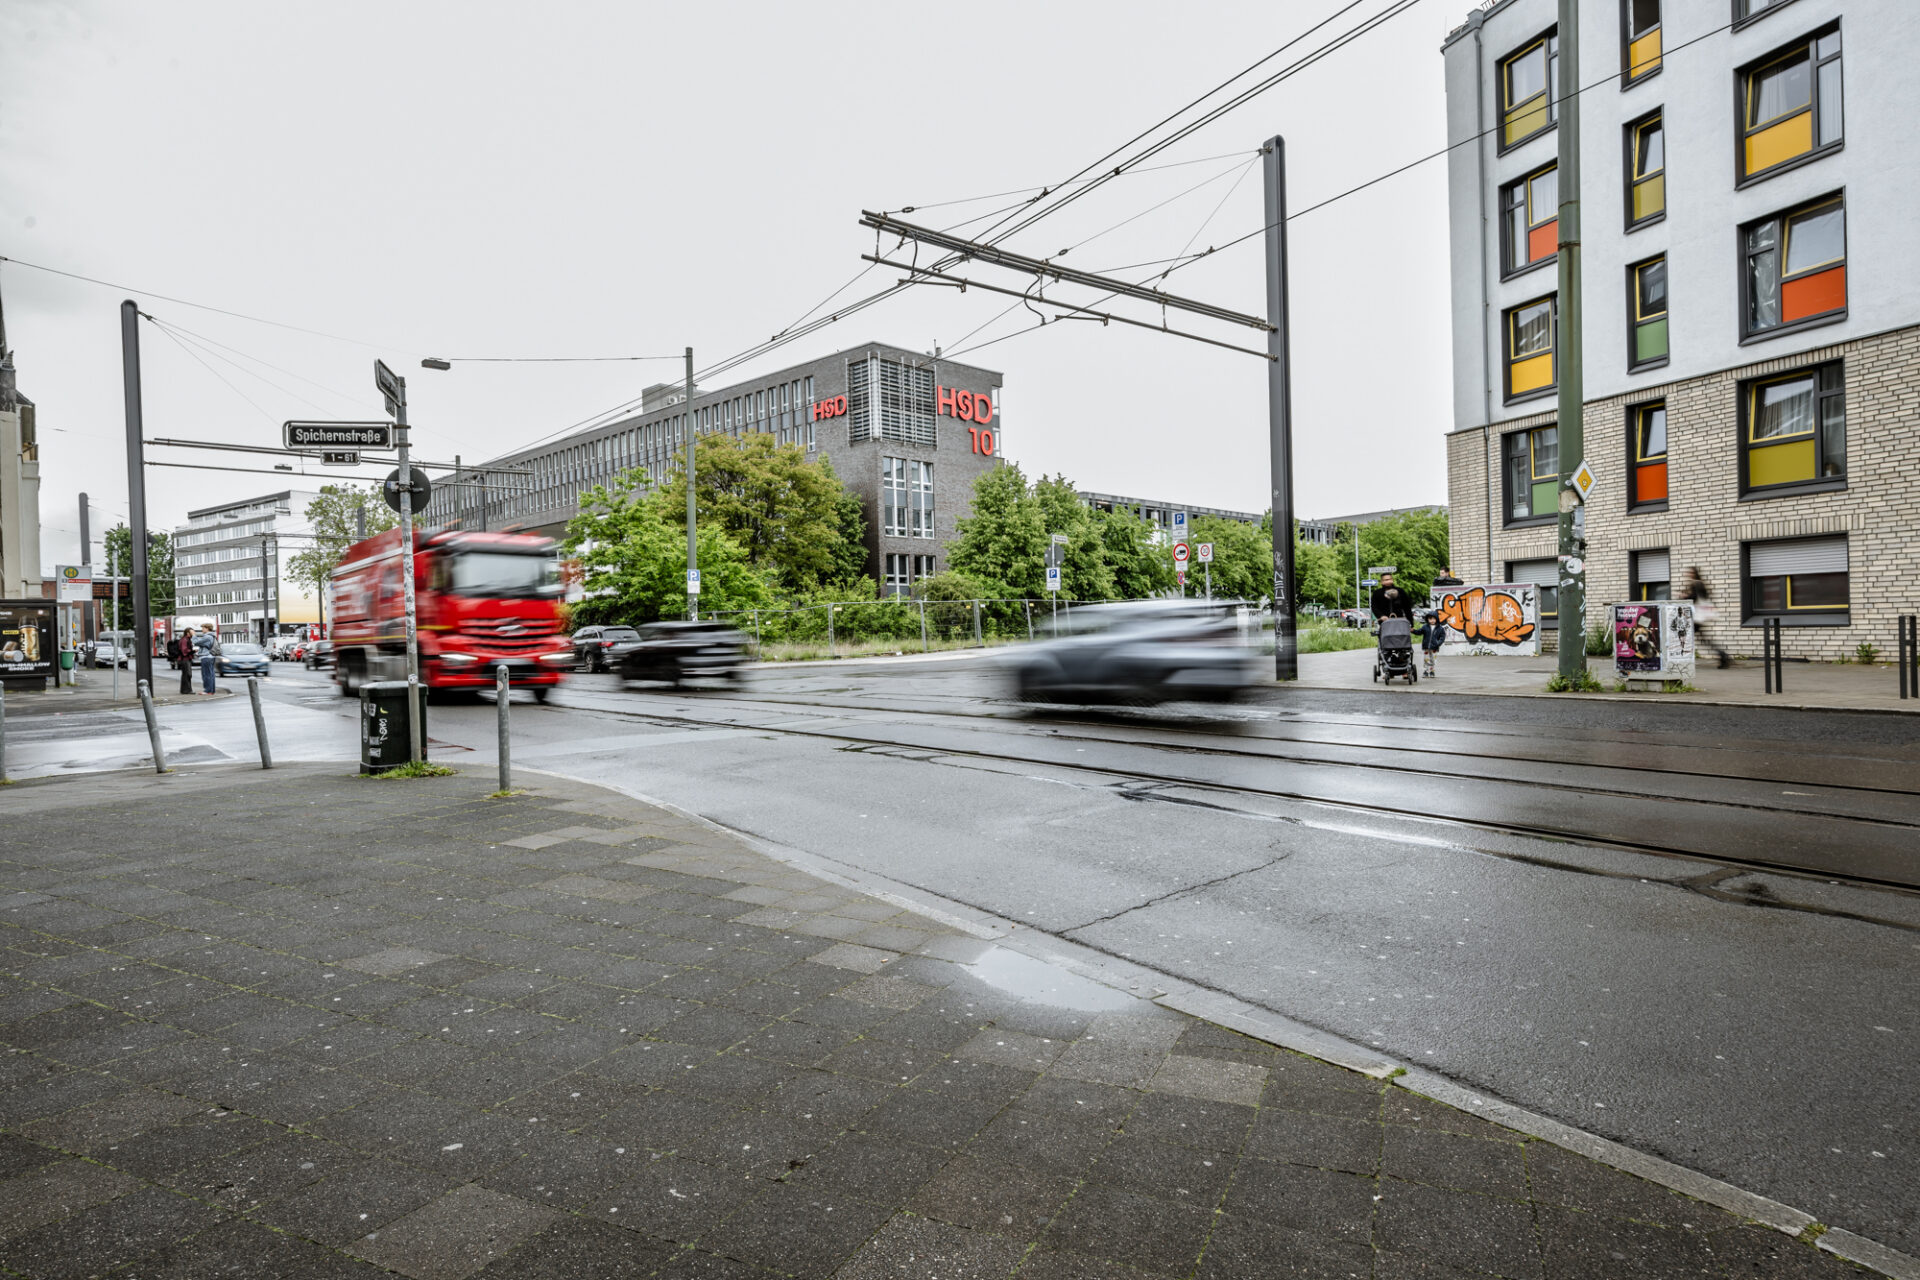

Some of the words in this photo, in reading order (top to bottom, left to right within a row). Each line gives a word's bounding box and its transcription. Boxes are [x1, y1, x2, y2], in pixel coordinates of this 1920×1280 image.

[813, 395, 847, 421] HSD
[937, 385, 993, 424] HSD
[295, 428, 381, 444] Spichernstraße
[969, 428, 993, 456] 10
[331, 453, 335, 462] 1
[344, 453, 354, 462] 61
[1176, 514, 1183, 524] P
[690, 571, 698, 581] P
